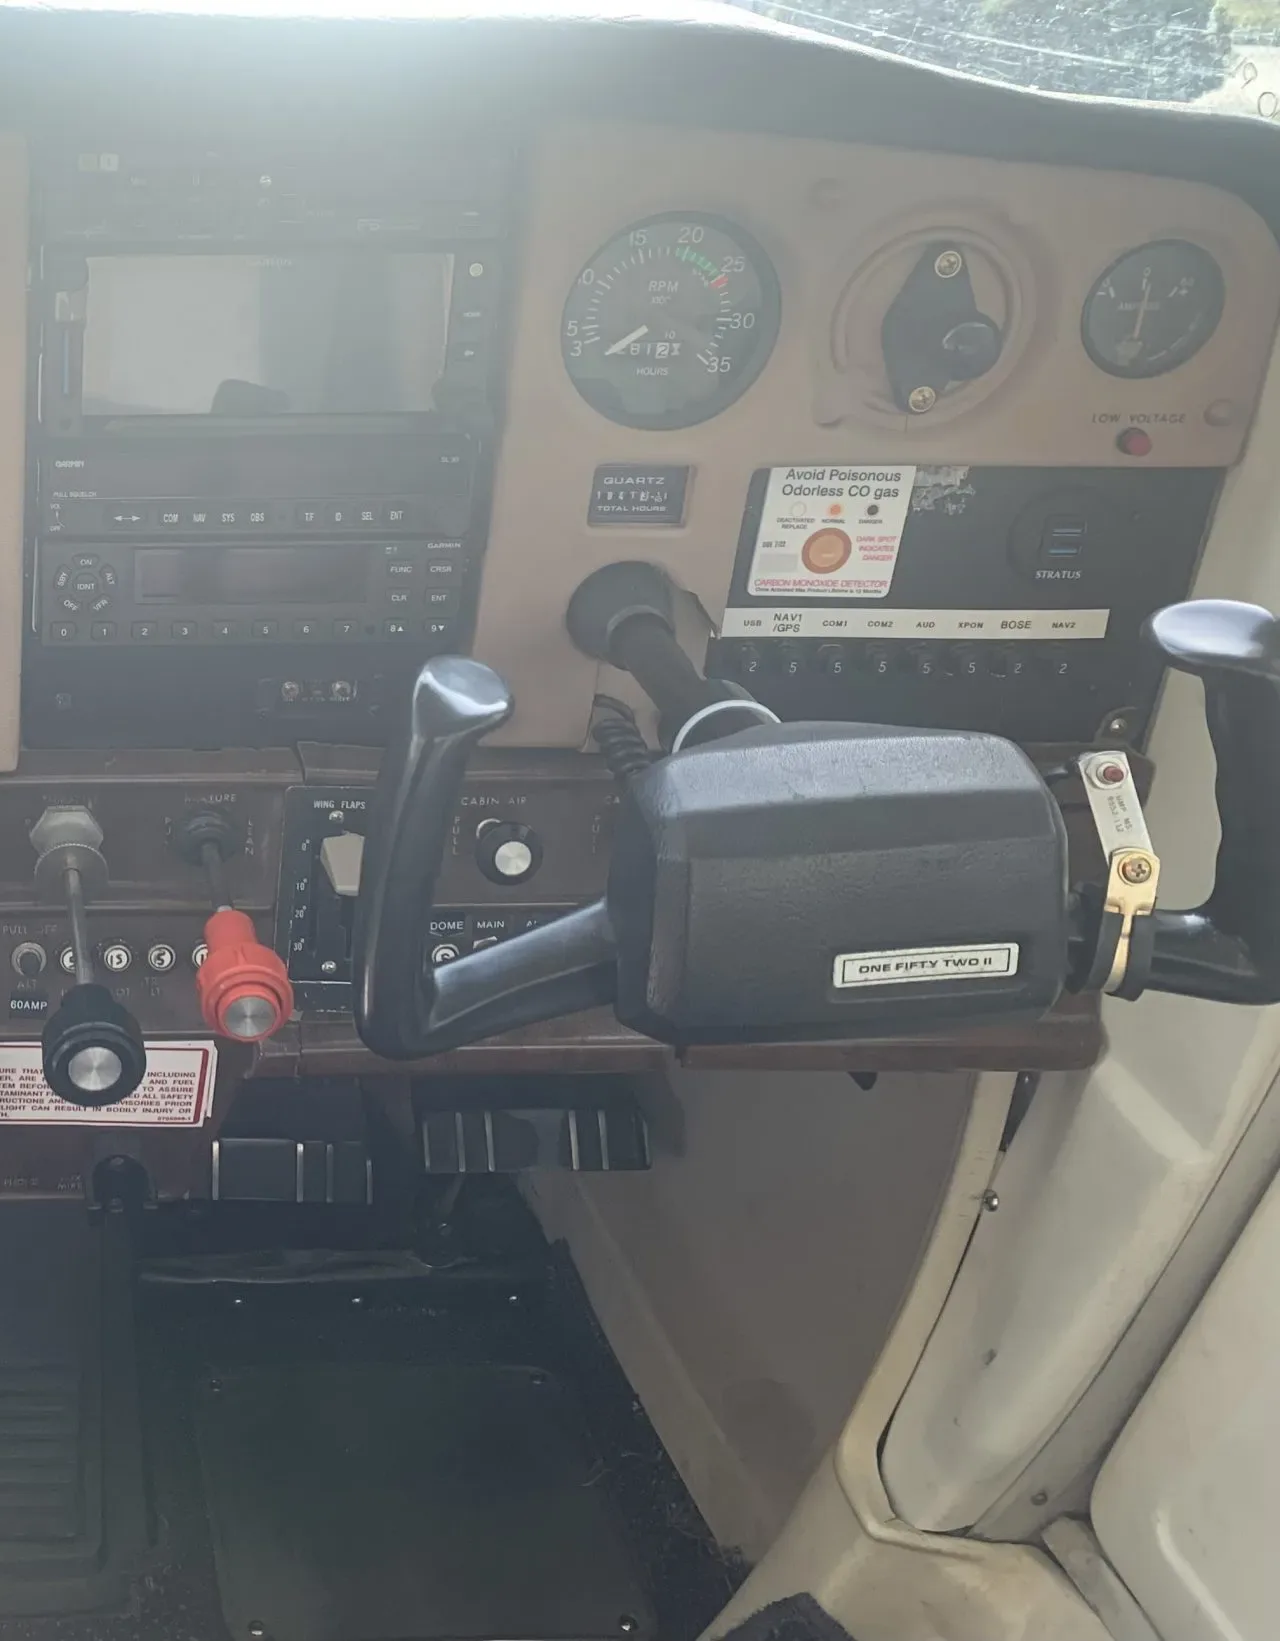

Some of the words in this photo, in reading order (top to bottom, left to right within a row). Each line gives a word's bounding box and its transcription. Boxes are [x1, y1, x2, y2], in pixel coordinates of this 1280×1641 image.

[629, 230, 648, 246] 15
[677, 226, 705, 244] 20
[720, 256, 745, 273] 25
[648, 280, 679, 293] RPM
[730, 313, 755, 329] 30
[566, 320, 579, 337] 5
[570, 340, 583, 357] 3
[706, 357, 732, 373] 35
[636, 367, 669, 376] HOURS
[1091, 413, 1121, 424] LOW
[1129, 413, 1186, 424] VOLTAGE
[786, 468, 825, 481] Avoid
[829, 470, 901, 482] Poisonous
[604, 477, 665, 485] QUARTZ
[782, 484, 844, 497] Odorless
[848, 485, 870, 497] CO
[873, 488, 899, 499] gas
[163, 513, 179, 523] COM
[221, 513, 236, 523] SYS
[1035, 570, 1081, 579] STRATUS
[431, 594, 447, 602] ENT
[743, 619, 762, 627] USB
[773, 613, 803, 623] NAV1
[867, 620, 894, 628] COM2
[1000, 621, 1032, 629] BOSE
[772, 624, 800, 633] /GPS
[313, 800, 335, 810] WING
[340, 801, 366, 810] FLAPS
[460, 796, 499, 806] CABIN
[508, 797, 527, 806] AIR
[430, 921, 465, 931] DOME
[476, 920, 505, 929] MAIN
[859, 963, 892, 974] ONE
[894, 960, 938, 971] FIFTY
[944, 958, 980, 967] TWO
[10, 1000, 48, 1010] 60AMP
